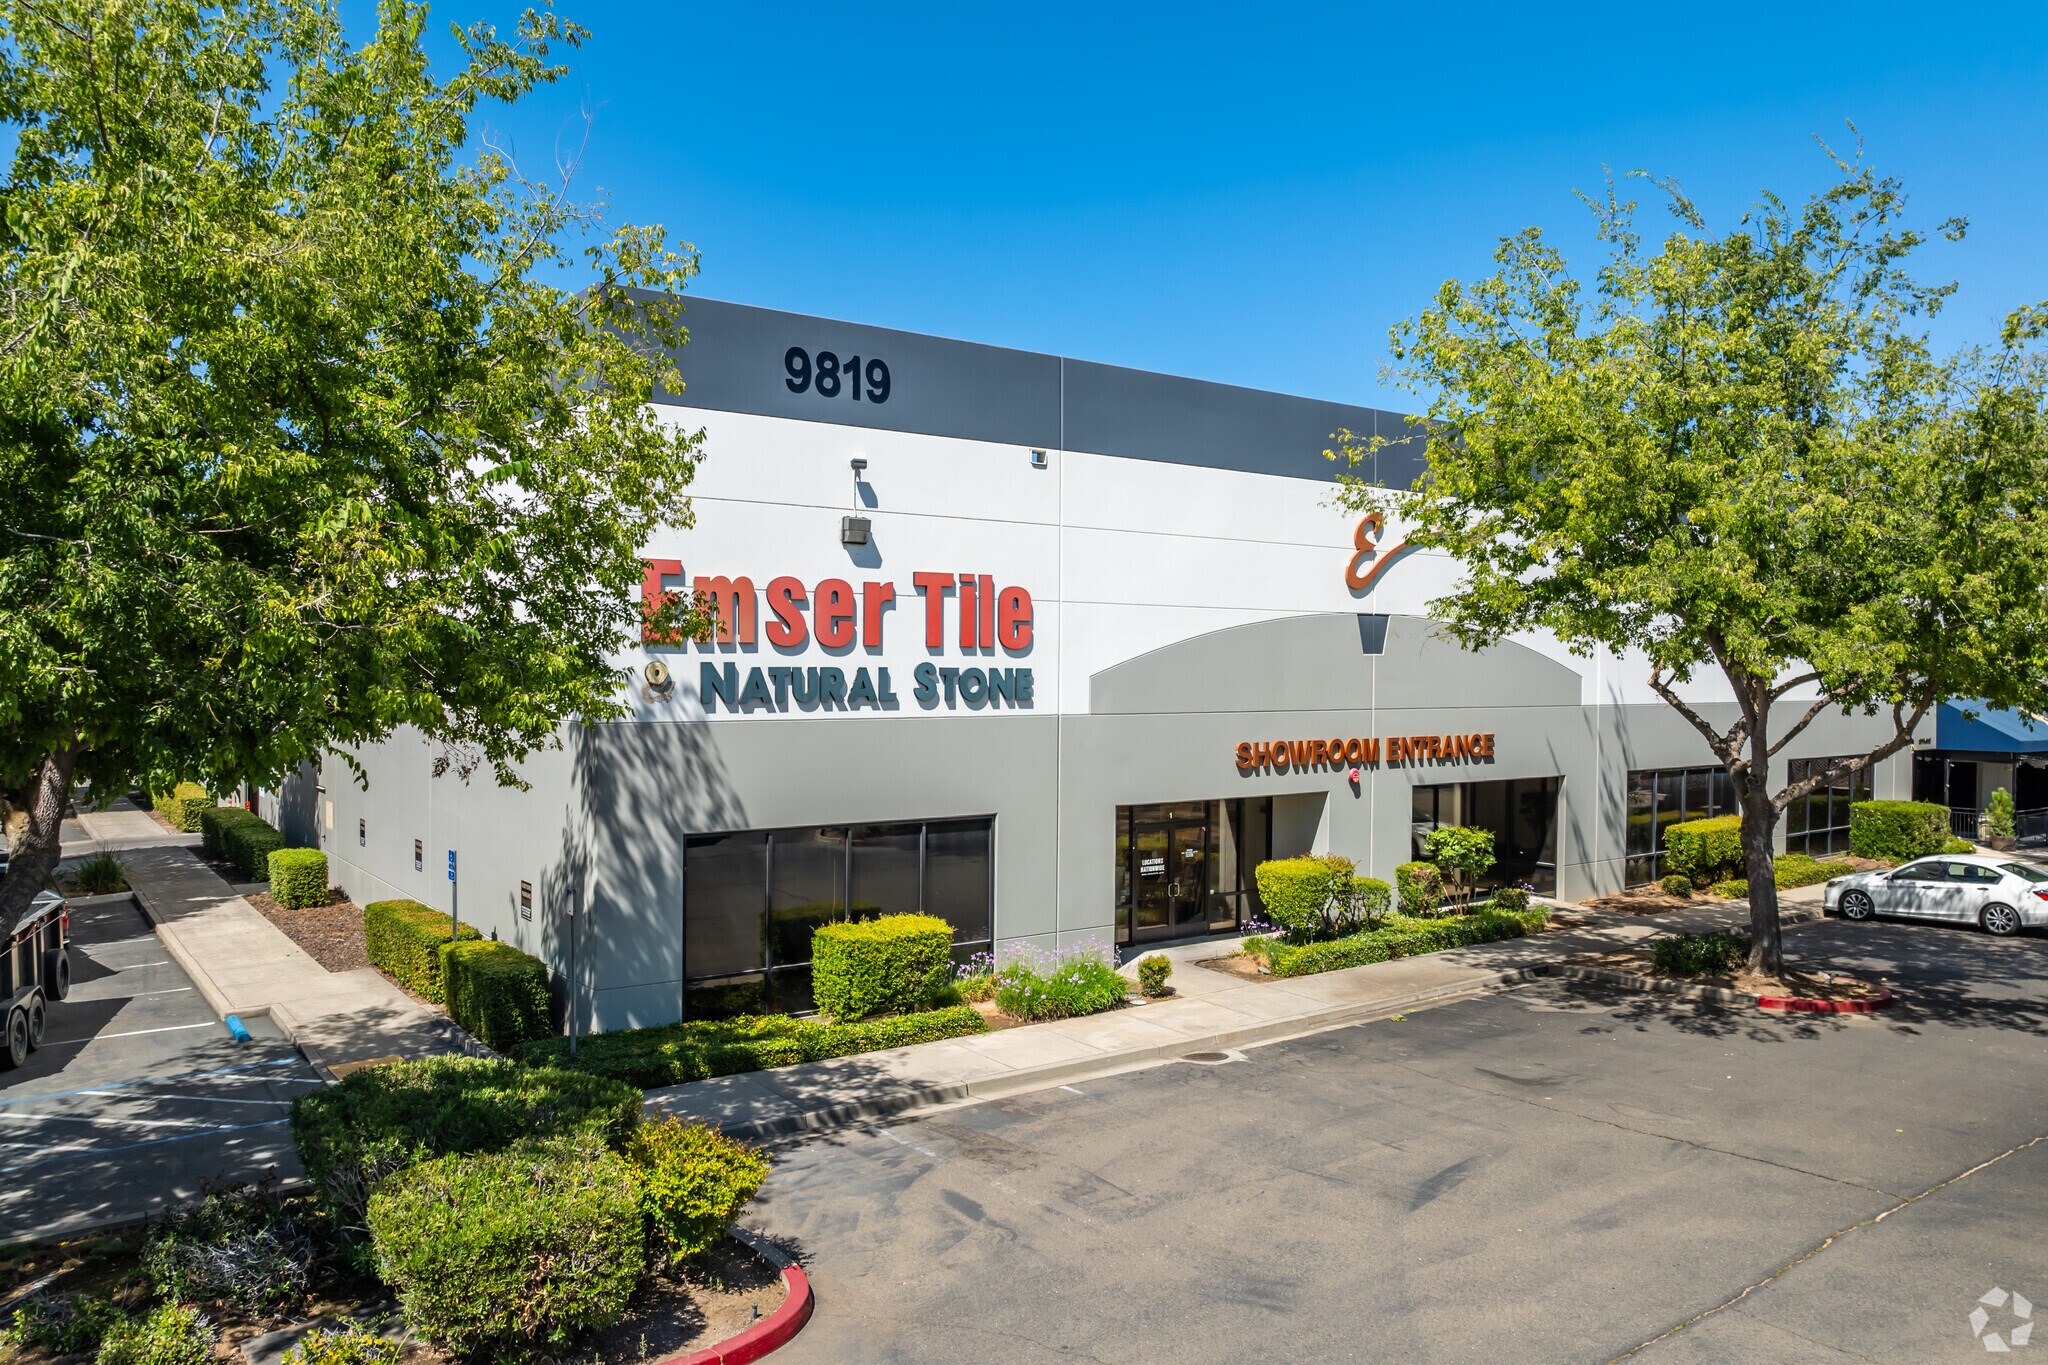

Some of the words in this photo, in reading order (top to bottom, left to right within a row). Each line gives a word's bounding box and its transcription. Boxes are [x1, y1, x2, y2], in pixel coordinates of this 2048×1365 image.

[784, 346, 891, 404] 9819
[641, 557, 894, 648] Emser
[913, 571, 1033, 650] Tile
[700, 661, 898, 704] NATURAL
[913, 662, 1034, 702] STONE
[1235, 737, 1380, 769] SHOWROOM
[1386, 733, 1495, 762] ENTRANCE
